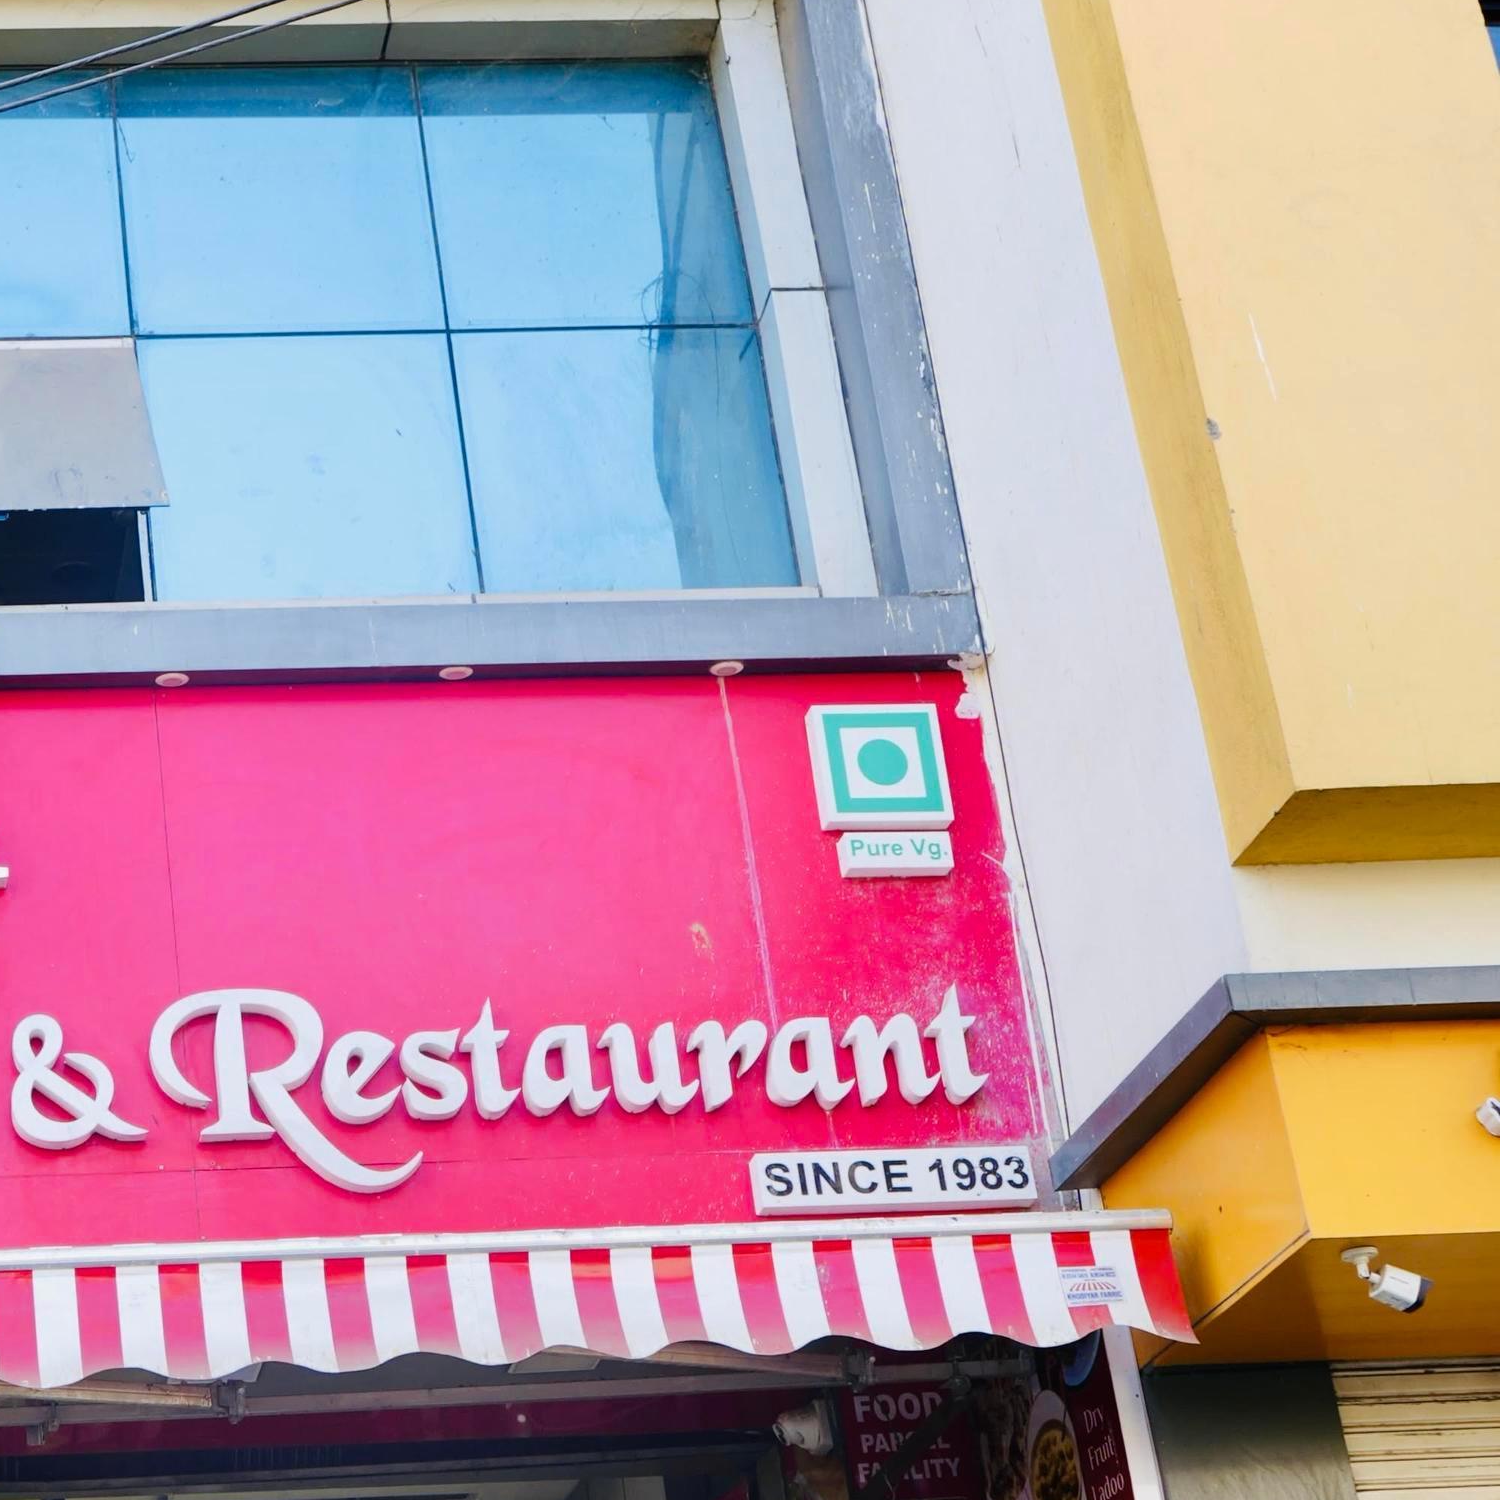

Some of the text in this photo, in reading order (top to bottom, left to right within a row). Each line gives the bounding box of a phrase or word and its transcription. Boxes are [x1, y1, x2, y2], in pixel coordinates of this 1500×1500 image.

[850, 838, 949, 860] Pure Vg.
[11, 1011, 147, 1148] &
[150, 986, 987, 1195] Restaurant
[765, 1156, 1030, 1197] SINCE 1983
